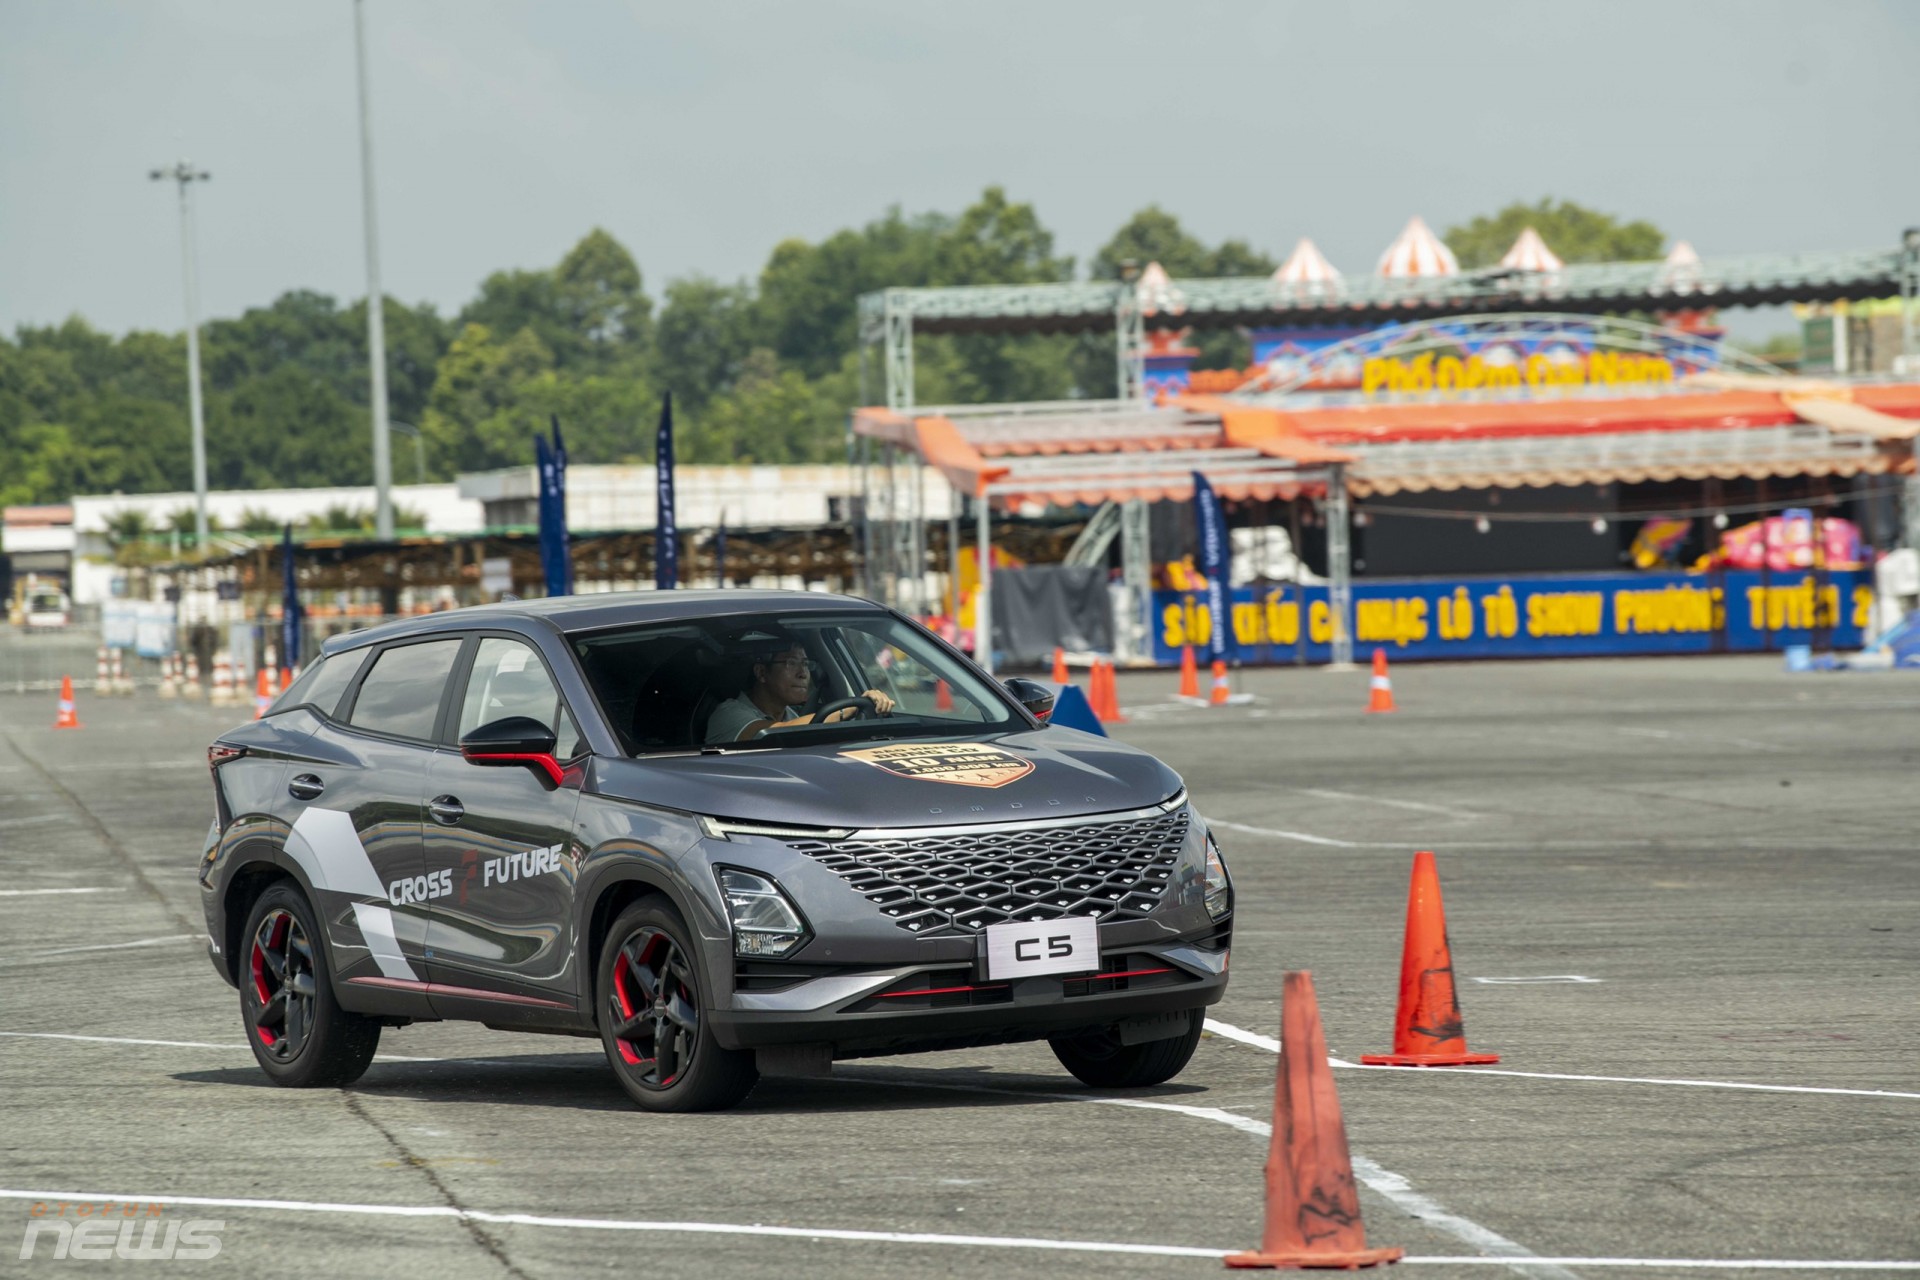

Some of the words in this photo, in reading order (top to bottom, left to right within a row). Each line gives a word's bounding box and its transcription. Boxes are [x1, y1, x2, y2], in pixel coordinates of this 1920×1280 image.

[1437, 585, 1474, 641] LÔ
[1481, 584, 1519, 639] TÔ
[1526, 592, 1604, 638] SHOW
[892, 757, 940, 768] 10
[389, 868, 453, 907] CROSS
[483, 843, 564, 888] FUTURE
[1014, 934, 1074, 963] C5
